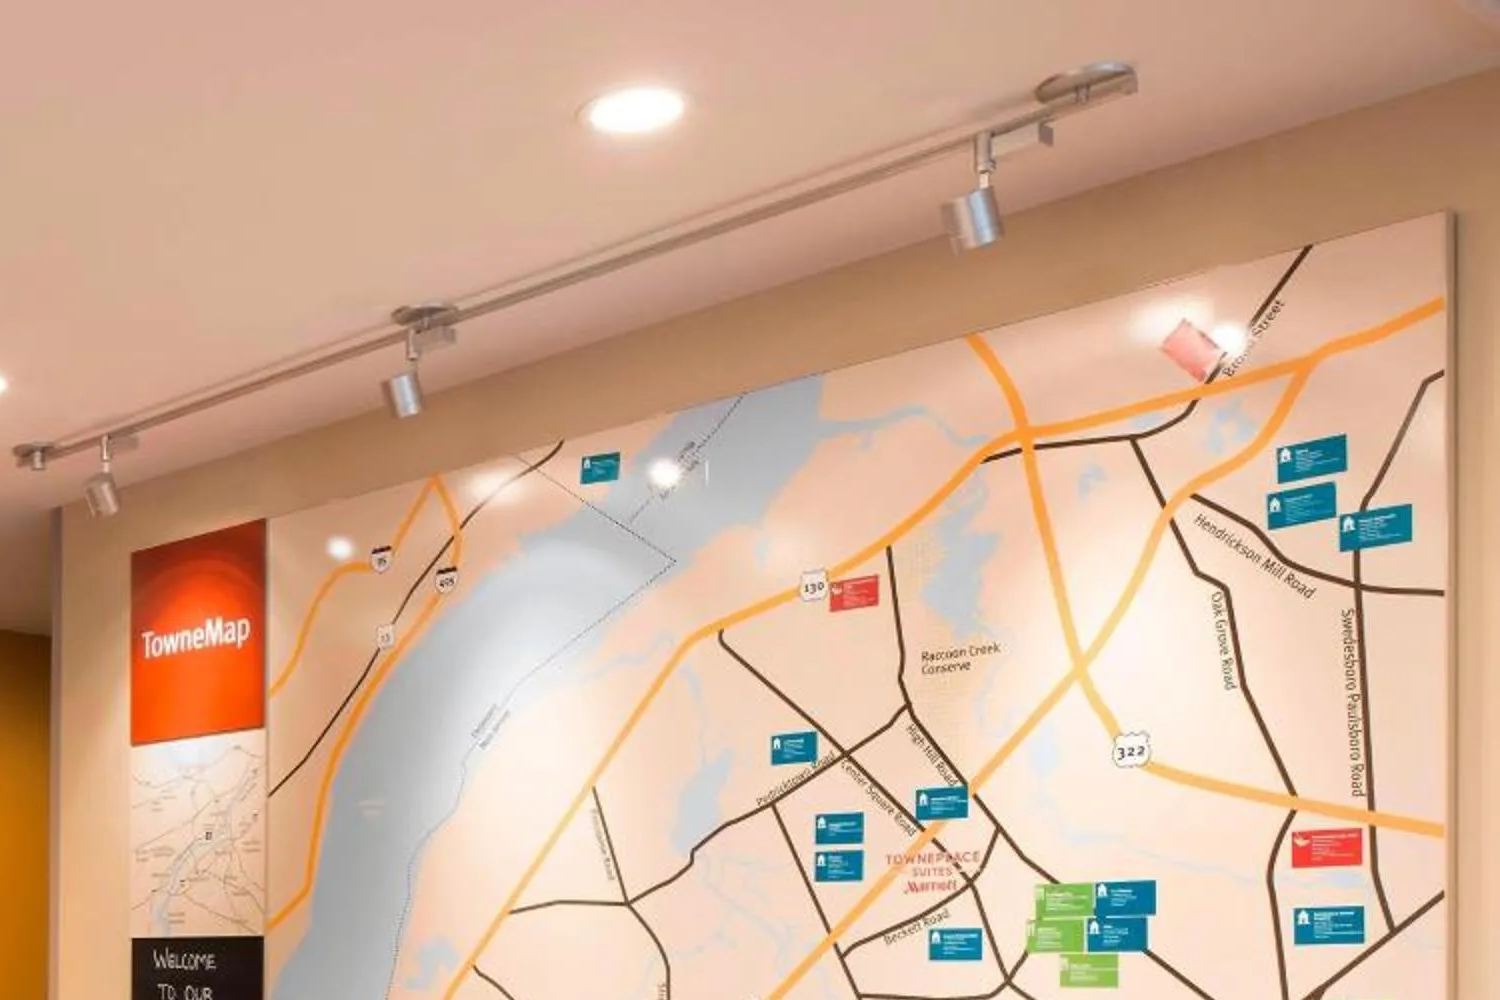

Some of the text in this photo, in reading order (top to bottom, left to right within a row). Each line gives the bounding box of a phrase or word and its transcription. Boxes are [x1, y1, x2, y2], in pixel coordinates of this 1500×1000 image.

[1252, 300, 1285, 336] Street
[1194, 513, 1317, 600] Hendrickson Mill Road
[804, 581, 825, 595] 130
[142, 616, 251, 660] TowneMap
[921, 641, 1002, 662] Raccoon Creek
[1211, 591, 1237, 691] Oak Grove Road
[921, 660, 972, 676] Conserve
[1341, 608, 1366, 798] Swedesboro Paulsboro Road
[1117, 745, 1146, 761] 322
[934, 759, 960, 787] Road
[841, 759, 866, 787] Center
[864, 782, 896, 818] Square
[912, 866, 953, 878] SUITES
[883, 920, 923, 946] Beckett
[922, 907, 951, 927] Road
[152, 947, 217, 971] WELCOME
[157, 983, 176, 1000] TO
